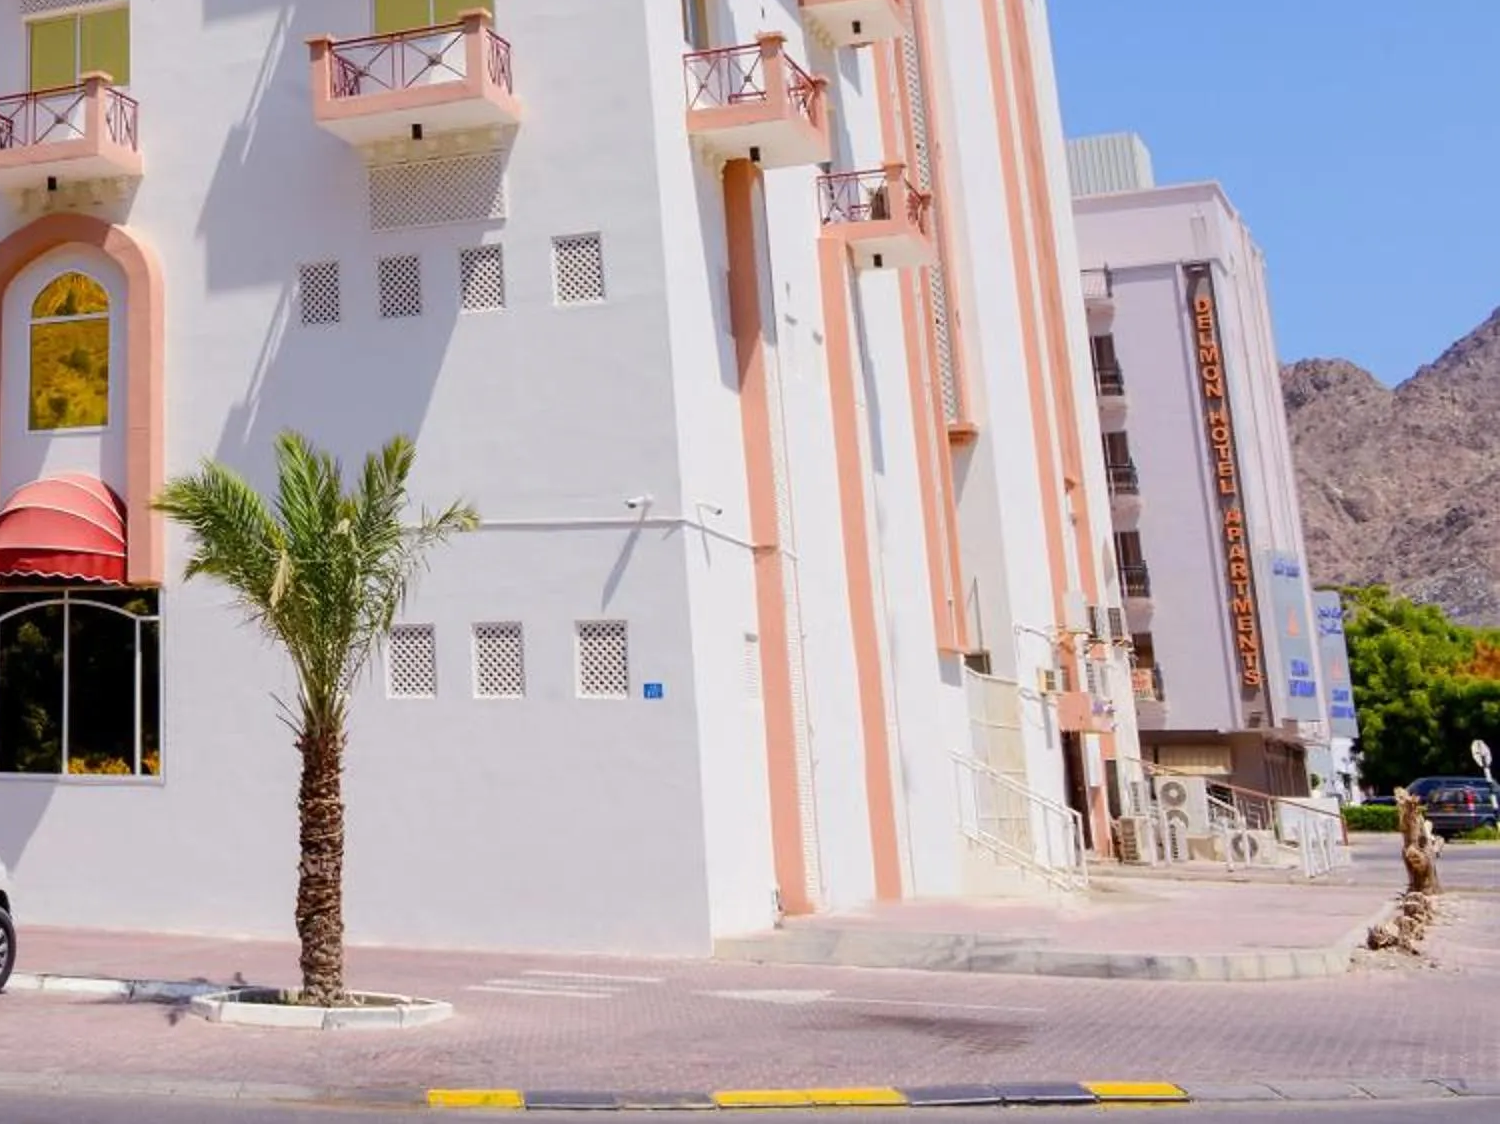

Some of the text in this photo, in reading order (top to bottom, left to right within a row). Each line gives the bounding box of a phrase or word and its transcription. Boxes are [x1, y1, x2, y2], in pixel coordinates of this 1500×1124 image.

[1194, 298, 1261, 686] DELMON HOTEL APARTMENTS
